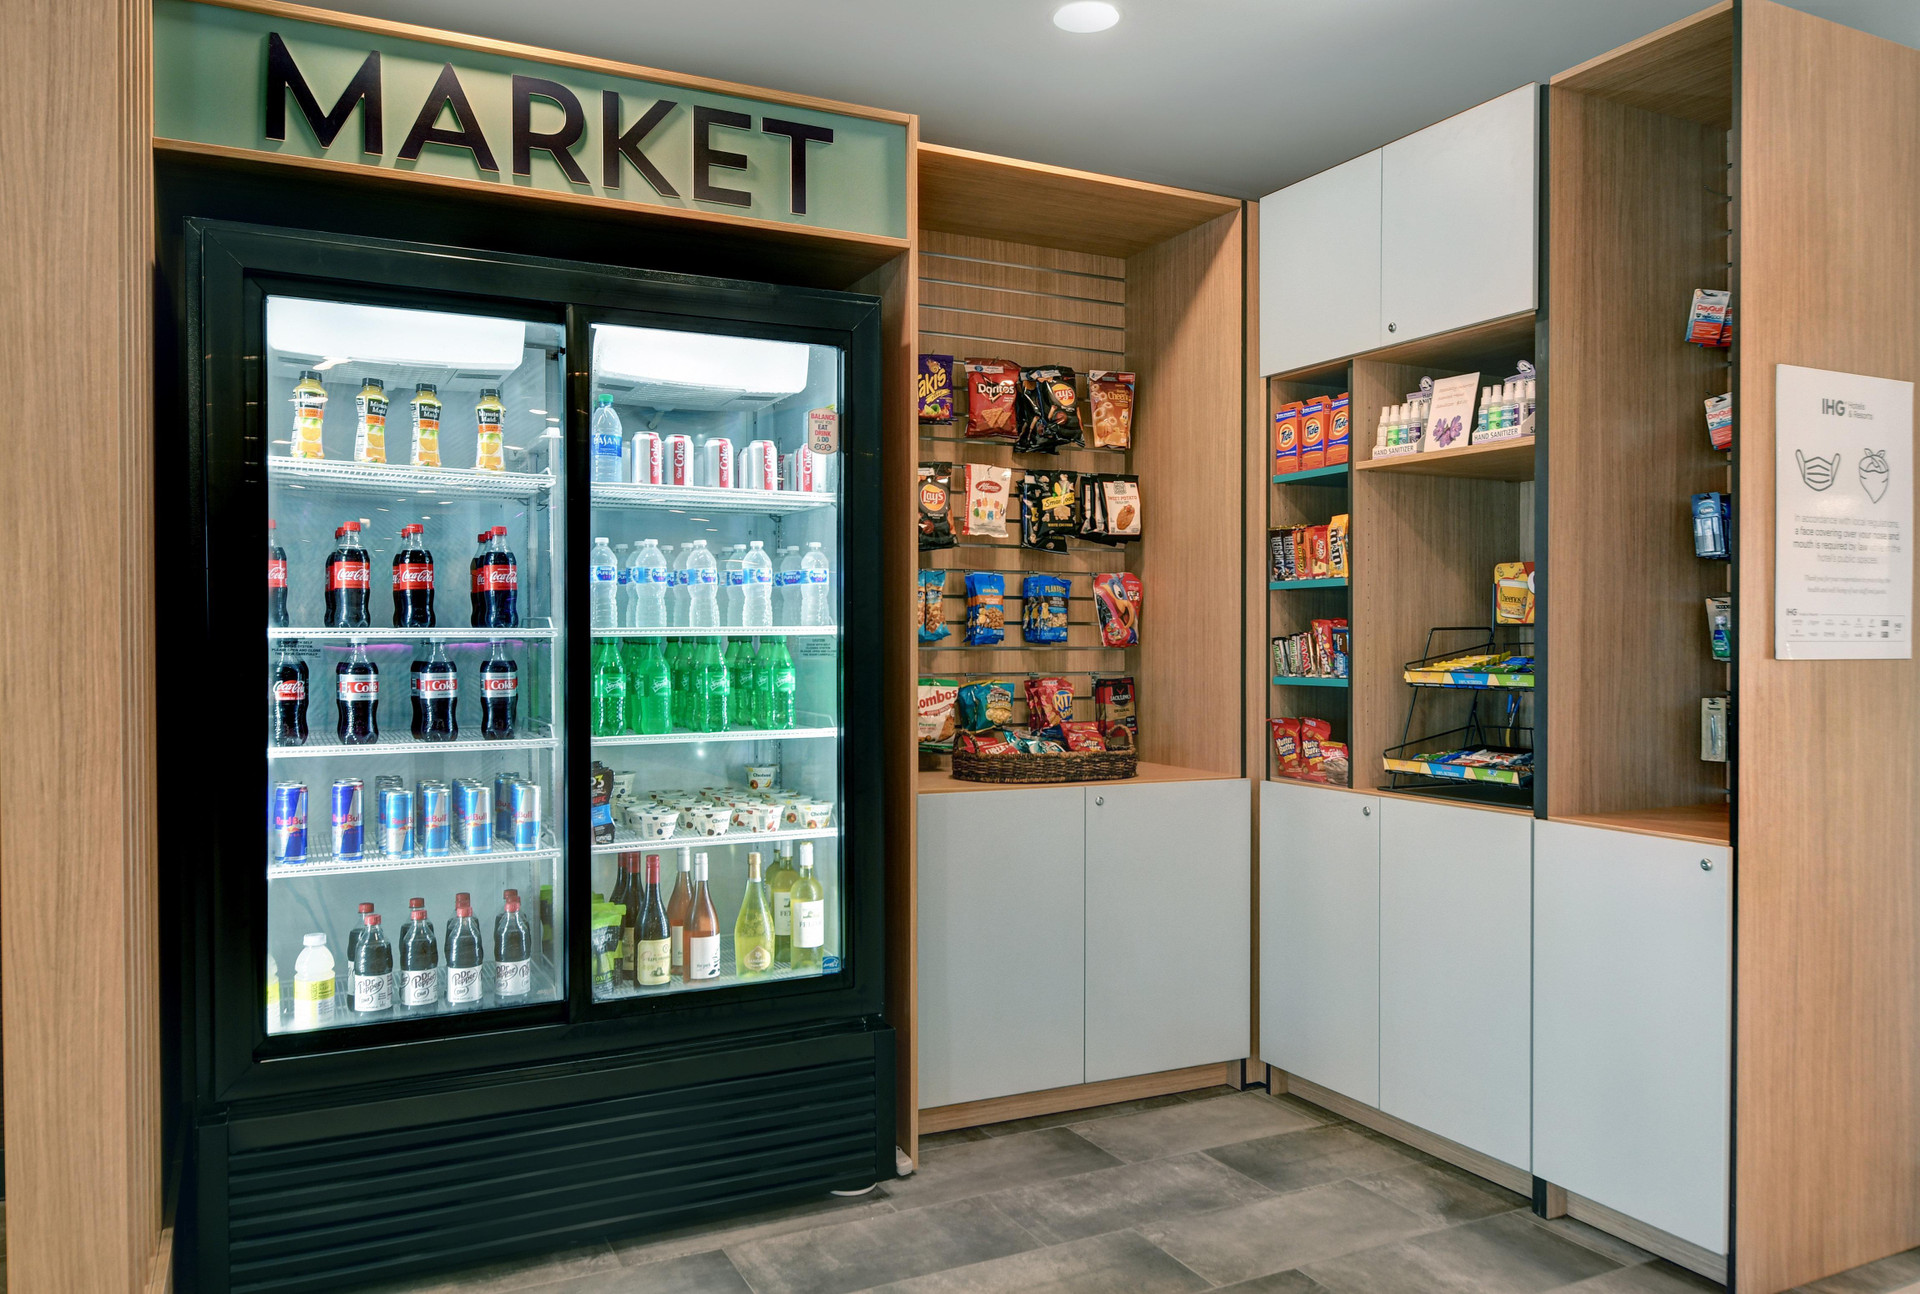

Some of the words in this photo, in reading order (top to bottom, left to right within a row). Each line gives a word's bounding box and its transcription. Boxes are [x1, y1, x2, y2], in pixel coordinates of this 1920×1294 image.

[265, 31, 834, 216] MARKET
[1697, 304, 1723, 312] DayQuil
[918, 368, 947, 398] akis
[977, 382, 1015, 398] Doritos
[1822, 398, 1845, 416] IHG
[811, 412, 836, 421] BALANCE
[1335, 417, 1348, 432] Tide
[1280, 430, 1293, 444] Tide
[1306, 425, 1319, 439] Tide
[1474, 432, 1489, 440] HAND
[1490, 428, 1519, 439] SANITIZER
[651, 439, 660, 466] Coke
[674, 441, 684, 467] Coke
[720, 445, 729, 470] Coke
[1374, 448, 1388, 456] HAND
[1388, 445, 1414, 455] SANITIZER
[764, 446, 773, 472] Coke
[803, 449, 812, 474] Coke
[337, 567, 370, 582] Coca-Cola
[401, 569, 433, 583] Coca-Cola
[354, 682, 378, 693] Coke
[432, 680, 456, 690] Coke
[491, 680, 514, 690] Coke
[918, 689, 958, 708] ombos
[432, 814, 447, 823] Bull
[473, 812, 488, 821] Bull
[414, 974, 436, 989] Pepper
[422, 972, 432, 980] Dr
[452, 972, 476, 986] Pepper
